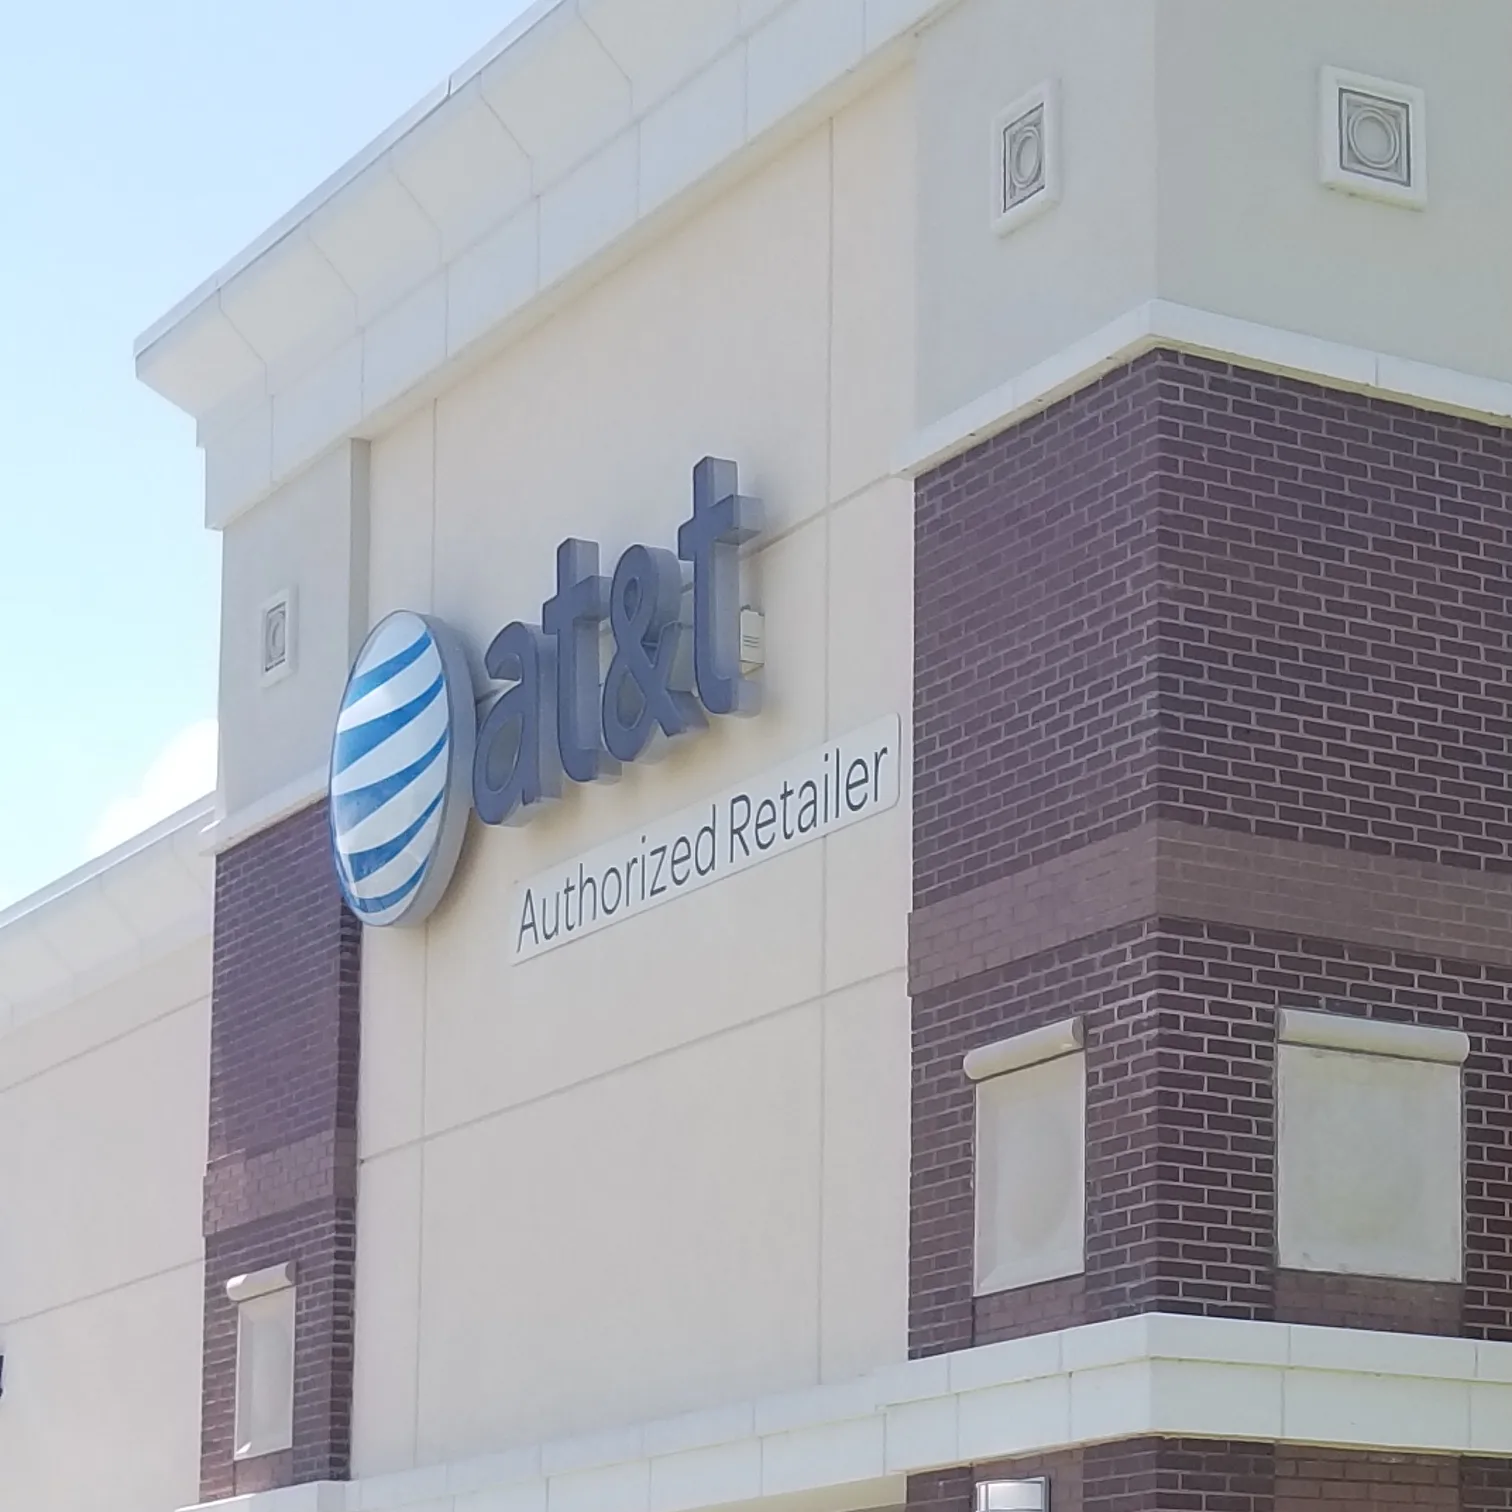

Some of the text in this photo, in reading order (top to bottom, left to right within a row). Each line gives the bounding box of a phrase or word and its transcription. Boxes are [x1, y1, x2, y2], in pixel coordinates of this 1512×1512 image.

[473, 456, 763, 827] at&t
[517, 746, 889, 953] Authorized Retailer
